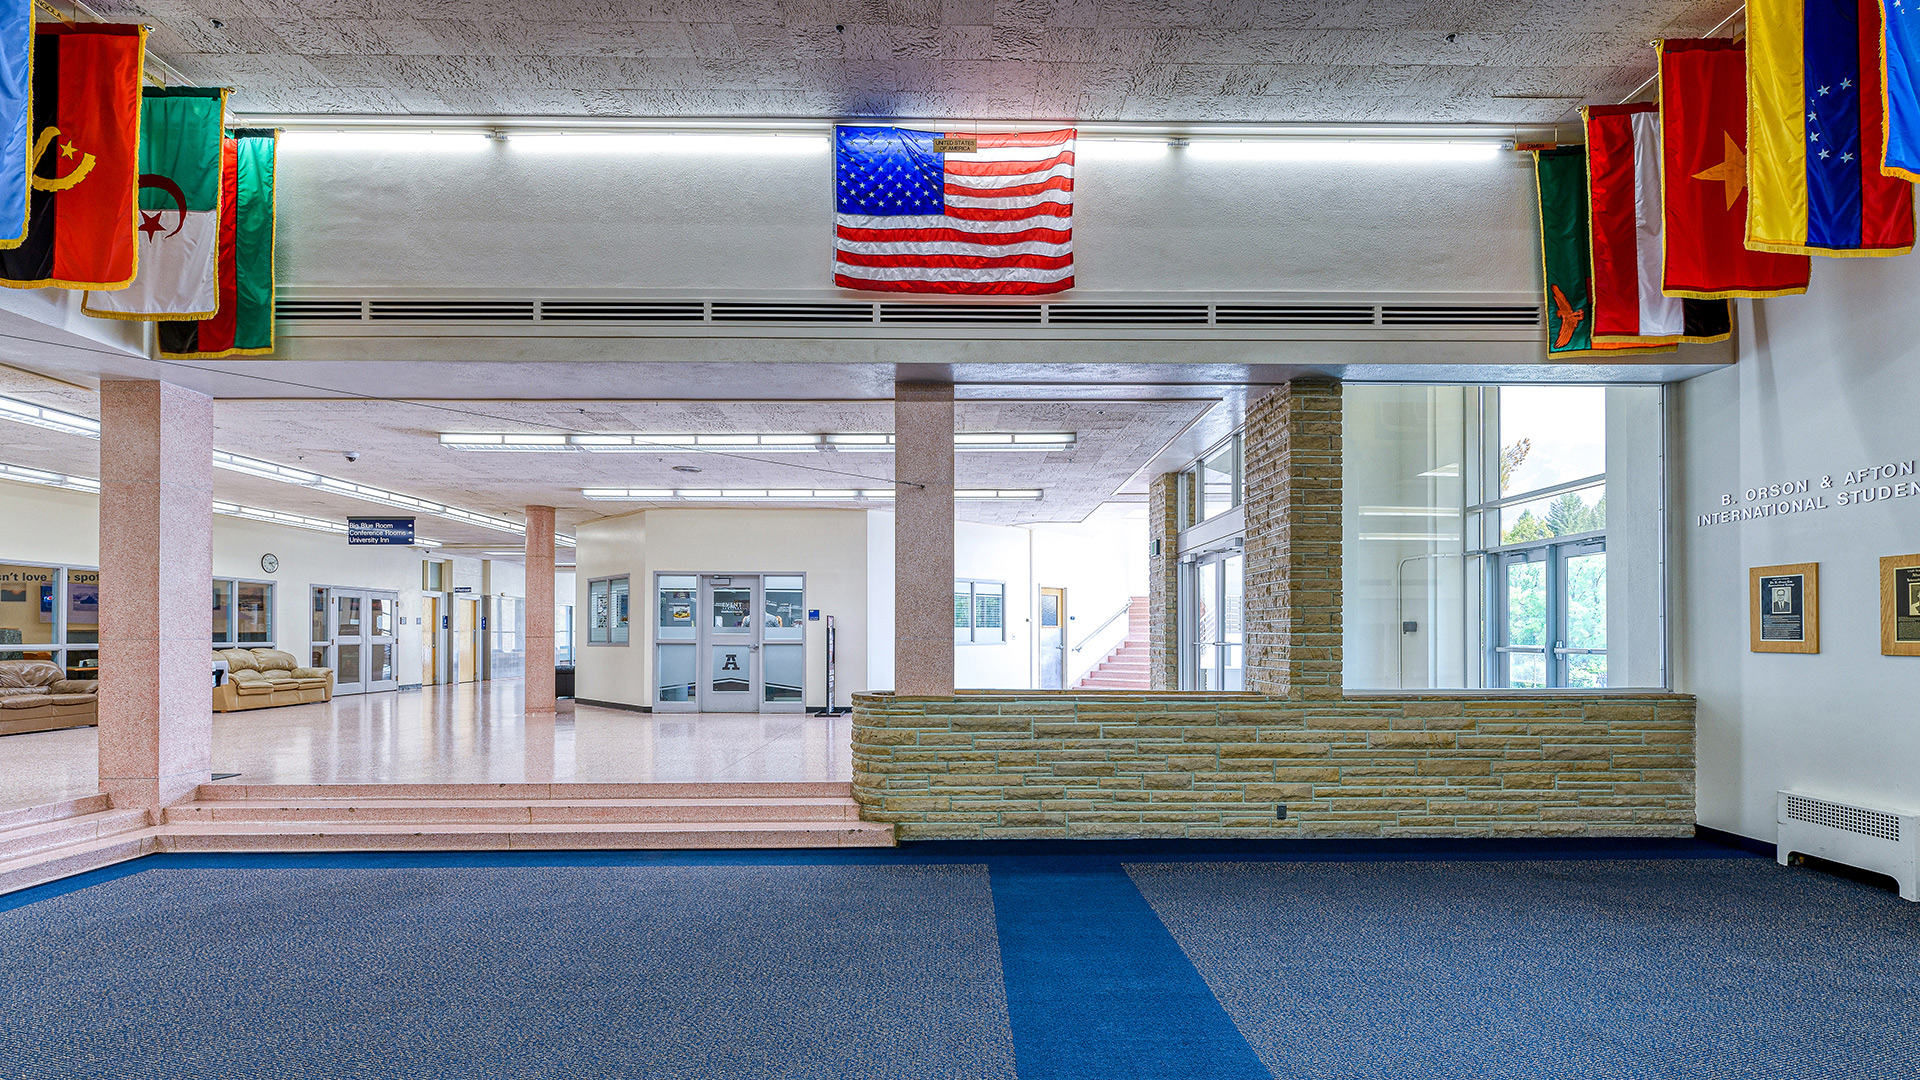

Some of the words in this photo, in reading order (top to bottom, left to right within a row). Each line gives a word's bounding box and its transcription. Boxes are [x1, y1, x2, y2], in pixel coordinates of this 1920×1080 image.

[1720, 494, 1738, 506] B.
[1745, 479, 1809, 502] ORSON
[1820, 475, 1833, 489] &
[1844, 460, 1915, 486] AFTON
[1697, 496, 1828, 527] INTERNATIONAL
[22, 572, 47, 582] love
